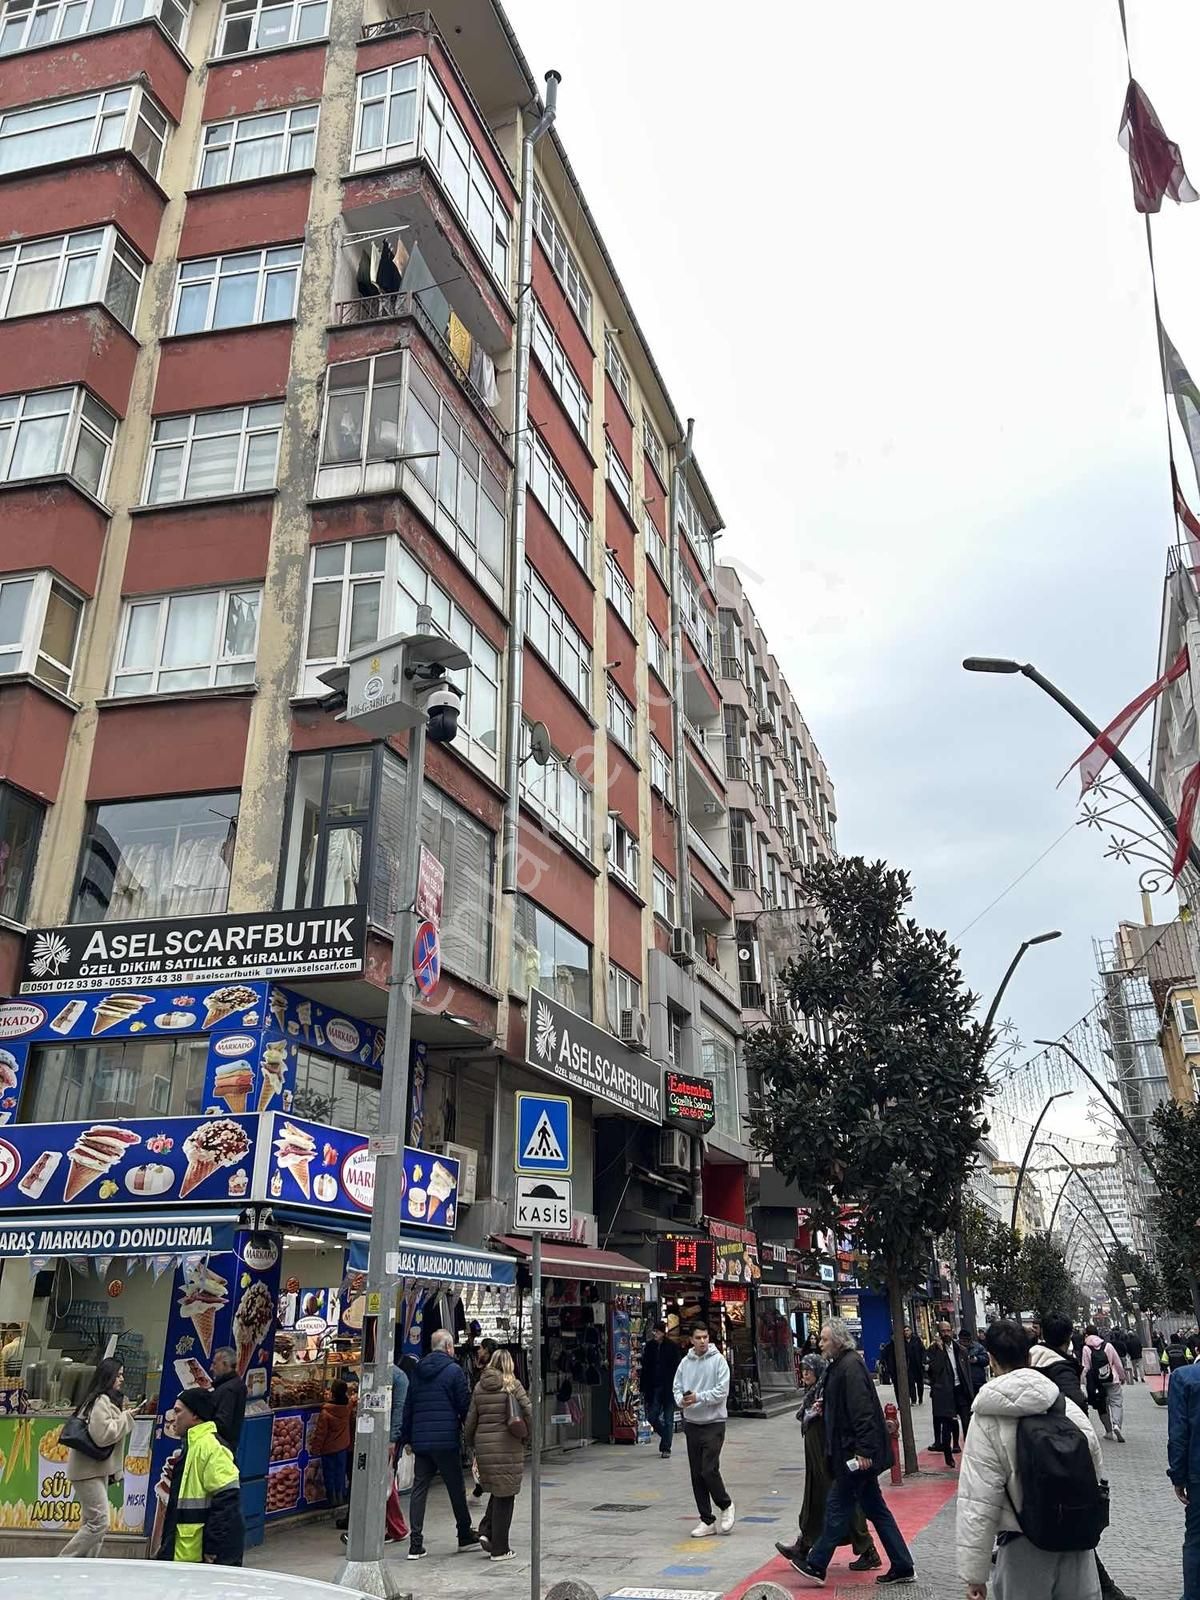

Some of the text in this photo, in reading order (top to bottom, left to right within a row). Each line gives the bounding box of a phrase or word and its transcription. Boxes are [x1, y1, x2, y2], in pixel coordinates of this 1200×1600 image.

[31, 982, 53, 991] 0501
[57, 981, 73, 989] 012
[76, 979, 88, 988] 93
[91, 979, 102, 987] 98
[136, 975, 153, 984] 725
[156, 974, 168, 983] 43
[171, 974, 182, 982] 38
[274, 961, 357, 974] www.aselscarf.com
[79, 963, 115, 976] ÖZEL
[165, 956, 223, 970] SATILIK
[227, 955, 237, 966] &
[519, 1204, 568, 1224] KASİS
[38, 1230, 115, 1249] MARKADO
[119, 1226, 213, 1248] DONDURMA
[417, 1254, 453, 1275] MARKADO
[454, 1258, 493, 1279] DONDURMA
[41, 1471, 72, 1498] SÜT
[31, 1500, 82, 1522] MISIR
